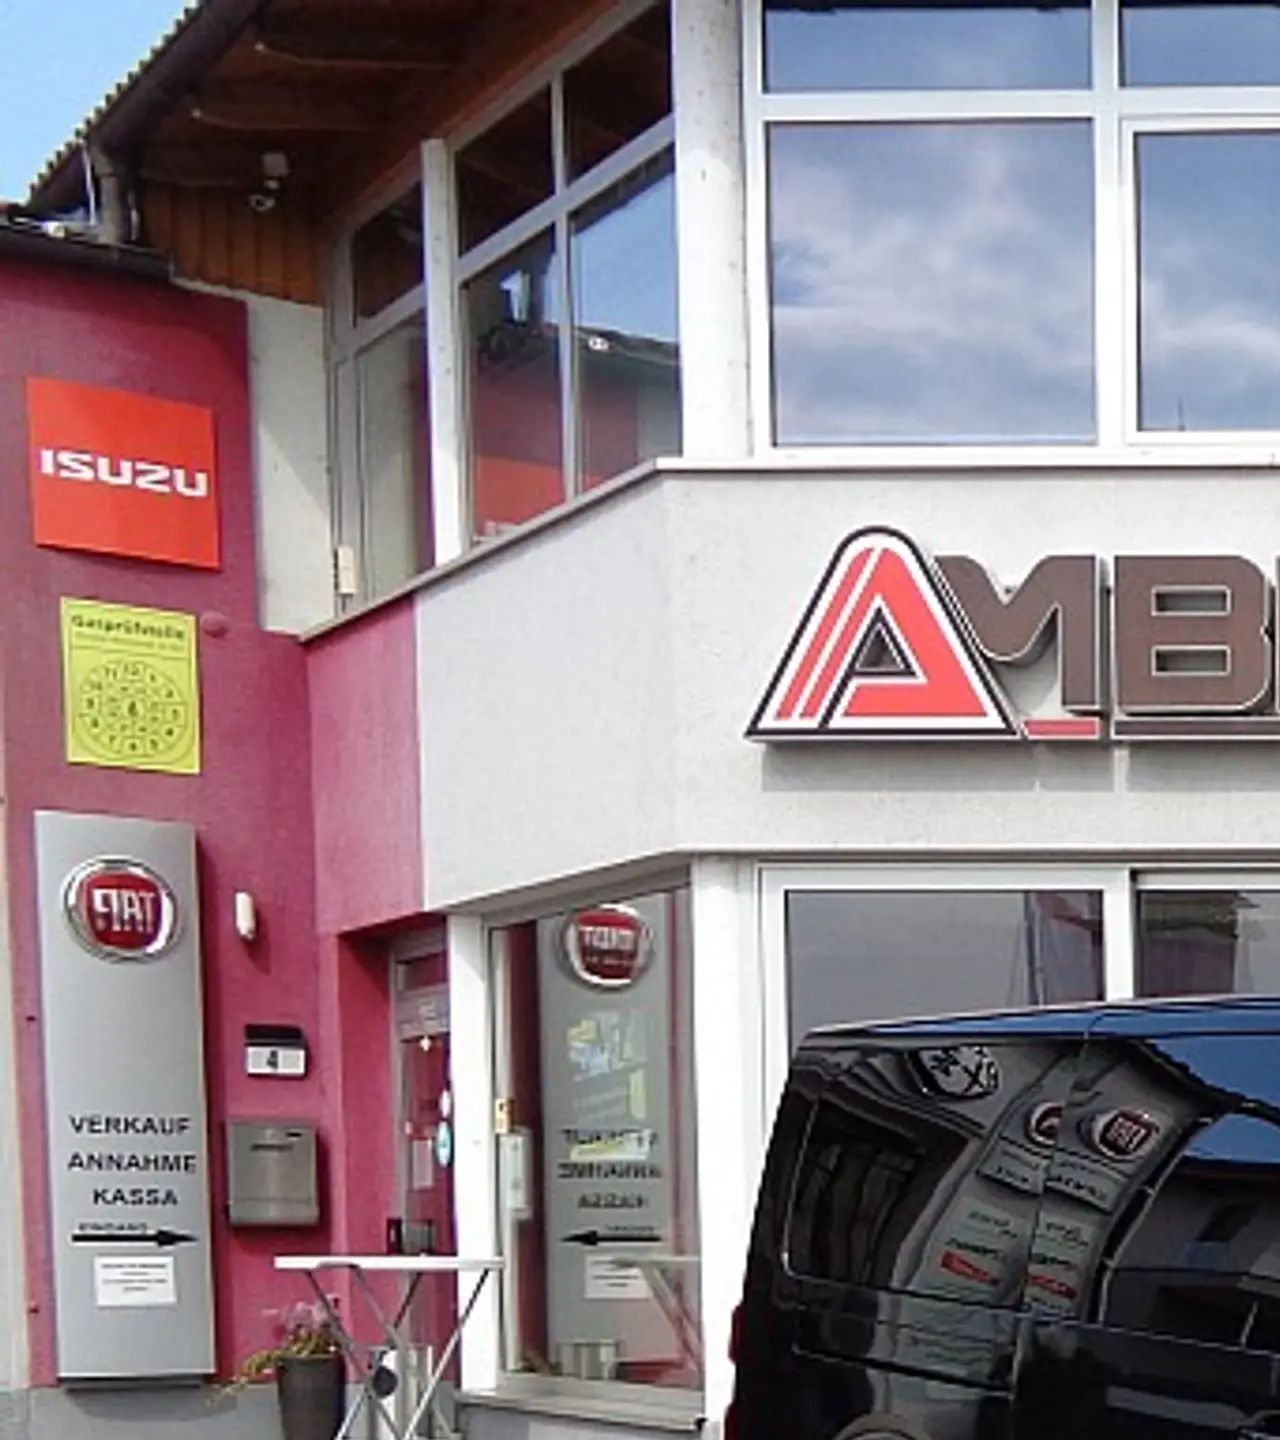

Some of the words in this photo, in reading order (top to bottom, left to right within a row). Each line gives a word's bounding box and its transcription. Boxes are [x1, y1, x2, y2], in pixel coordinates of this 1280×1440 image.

[40, 449, 209, 497] ISUZU
[92, 888, 156, 933] FIAT
[68, 1114, 192, 1135] VERKAUF
[67, 1152, 197, 1174] ANNAHME
[93, 1188, 179, 1207] KASSA
